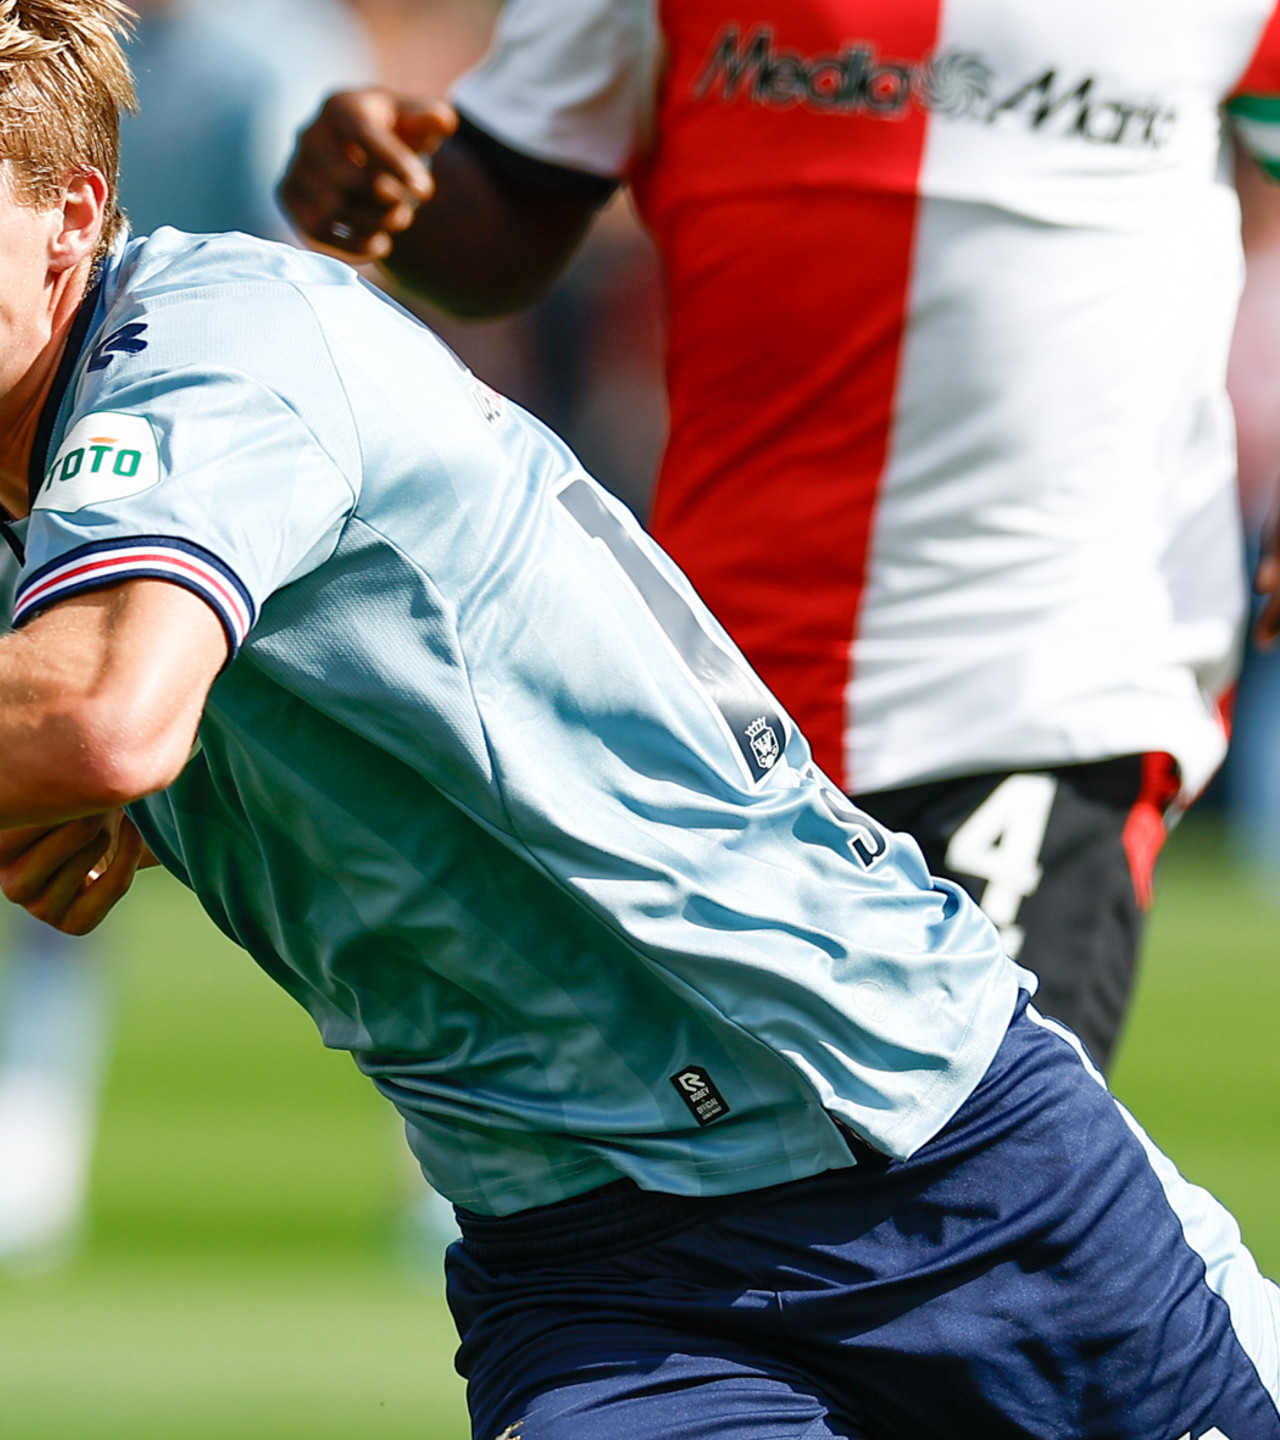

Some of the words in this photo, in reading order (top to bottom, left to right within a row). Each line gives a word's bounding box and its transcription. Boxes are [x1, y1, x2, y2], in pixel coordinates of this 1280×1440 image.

[693, 22, 912, 117] Media
[44, 444, 143, 492] TOTO
[943, 771, 1058, 932] 4
